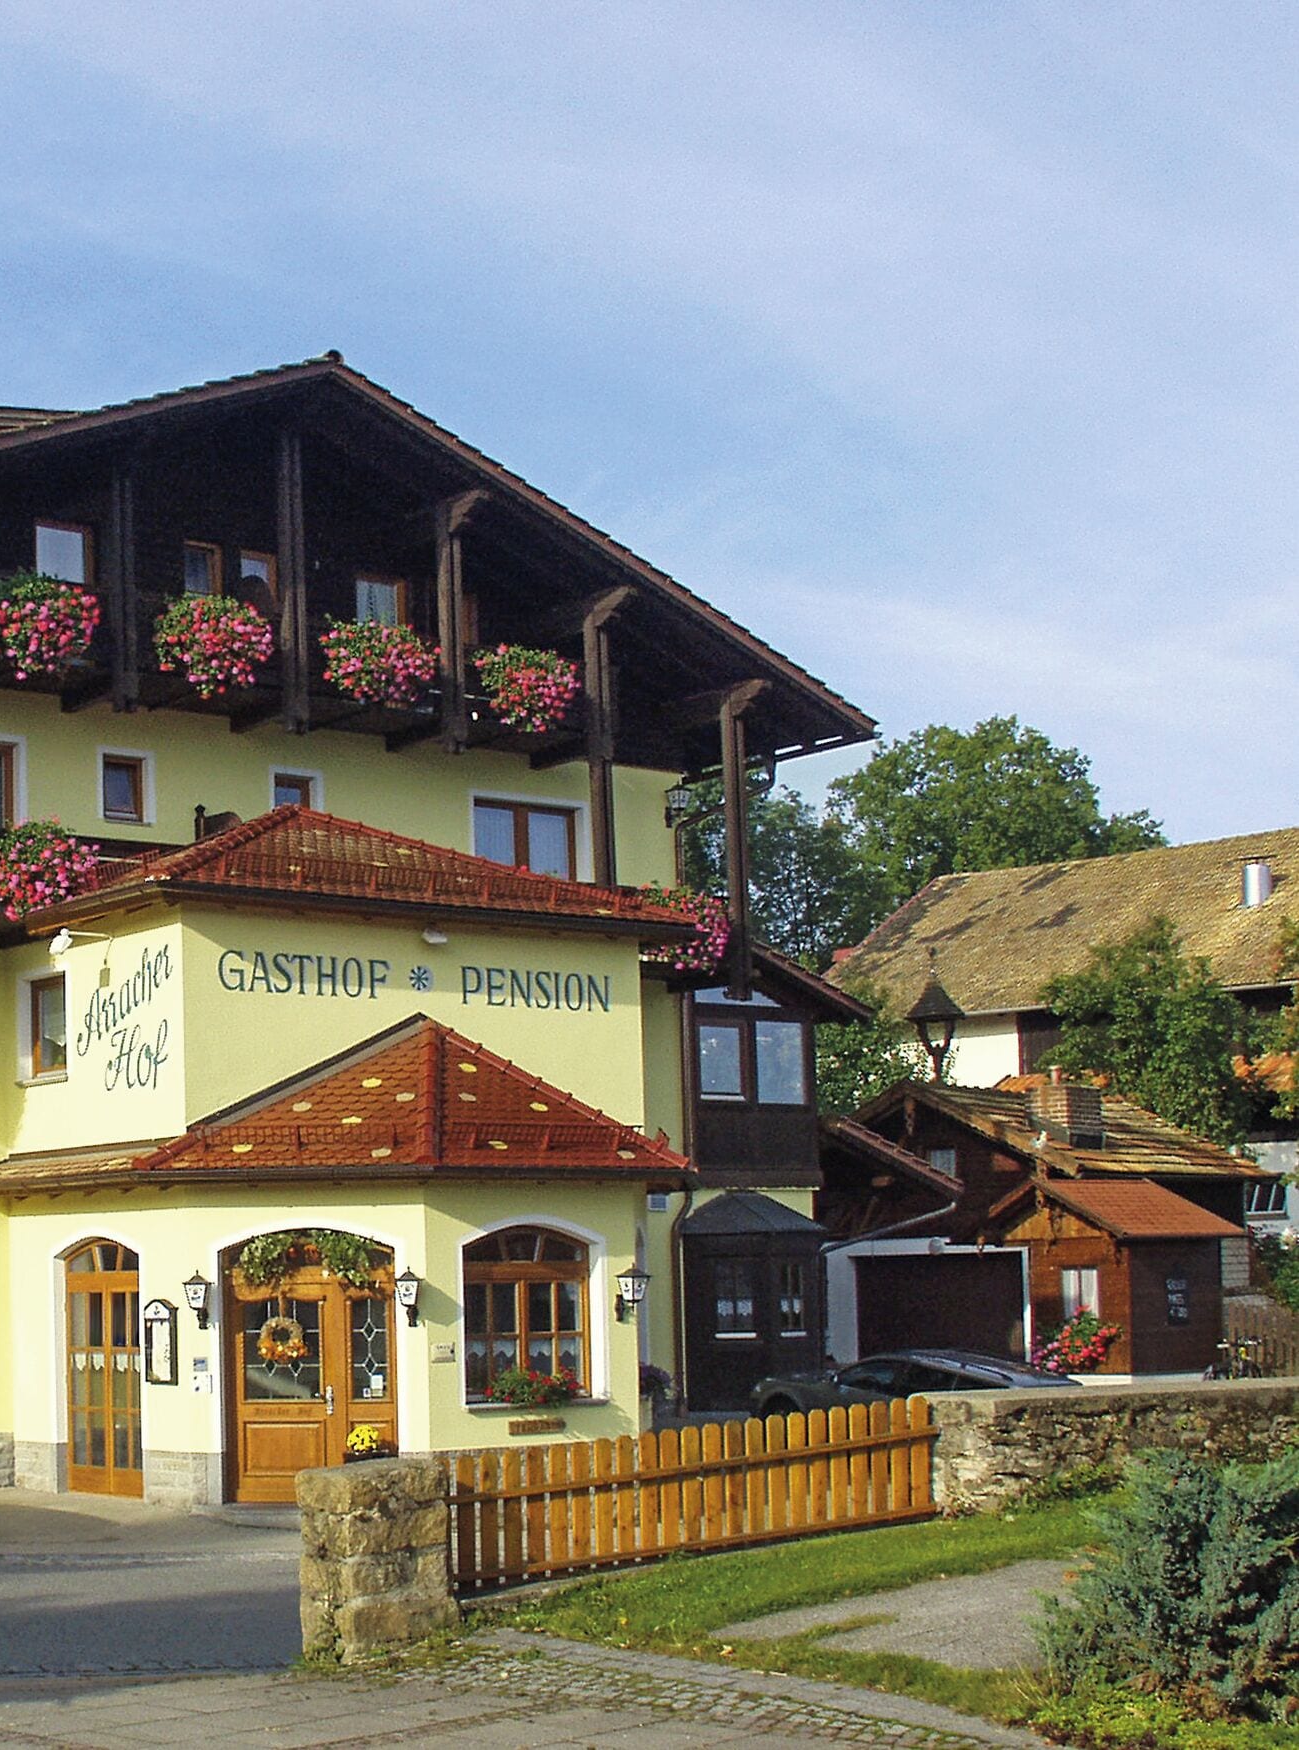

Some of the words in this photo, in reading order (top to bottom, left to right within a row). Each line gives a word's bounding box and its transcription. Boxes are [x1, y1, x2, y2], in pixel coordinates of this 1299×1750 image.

[77, 944, 173, 1056] Arracher
[217, 950, 390, 999] GASTHOF
[461, 965, 610, 1012] PENSION
[105, 1018, 169, 1091] Hof
